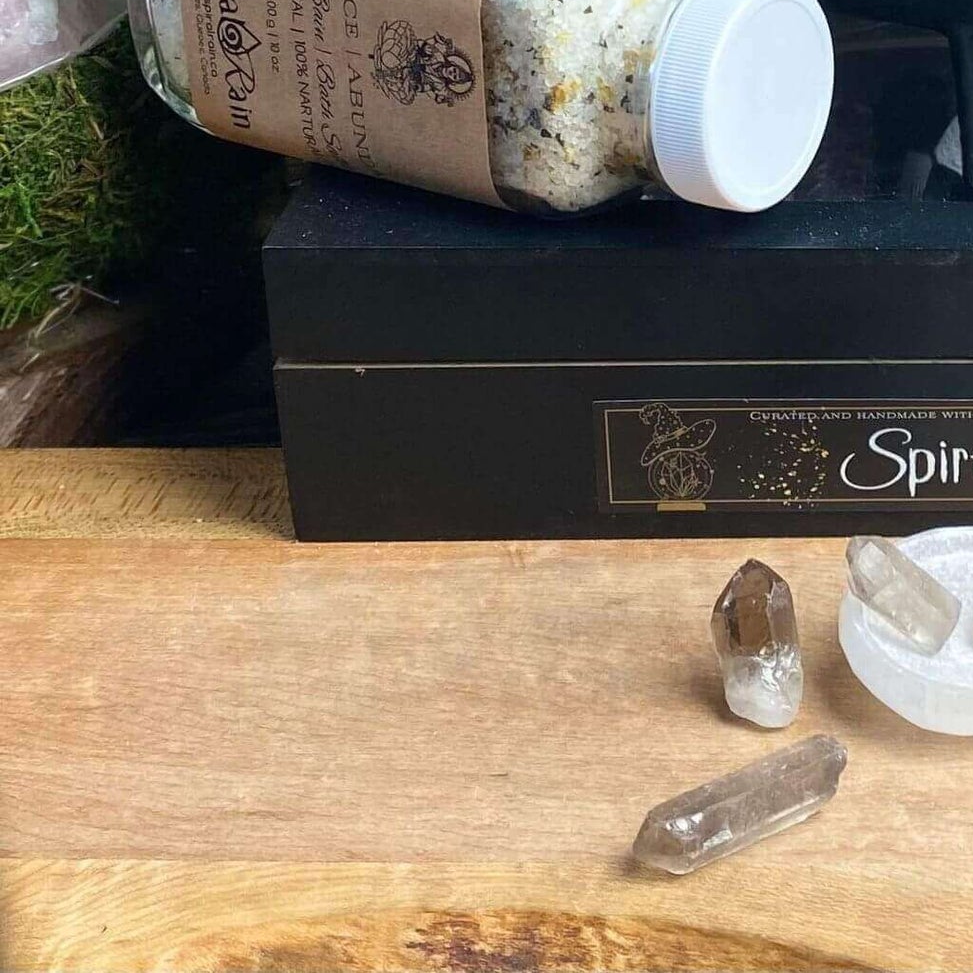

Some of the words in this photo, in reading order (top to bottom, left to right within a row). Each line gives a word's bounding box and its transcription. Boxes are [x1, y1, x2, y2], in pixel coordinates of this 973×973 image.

[268, 42, 280, 52] 10
[294, 40, 308, 77] 100%
[271, 56, 280, 73] oz
[221, 51, 255, 129] Rain
[315, 60, 336, 122] Bath
[821, 410, 852, 420] AND
[857, 410, 937, 420] HANDMADE
